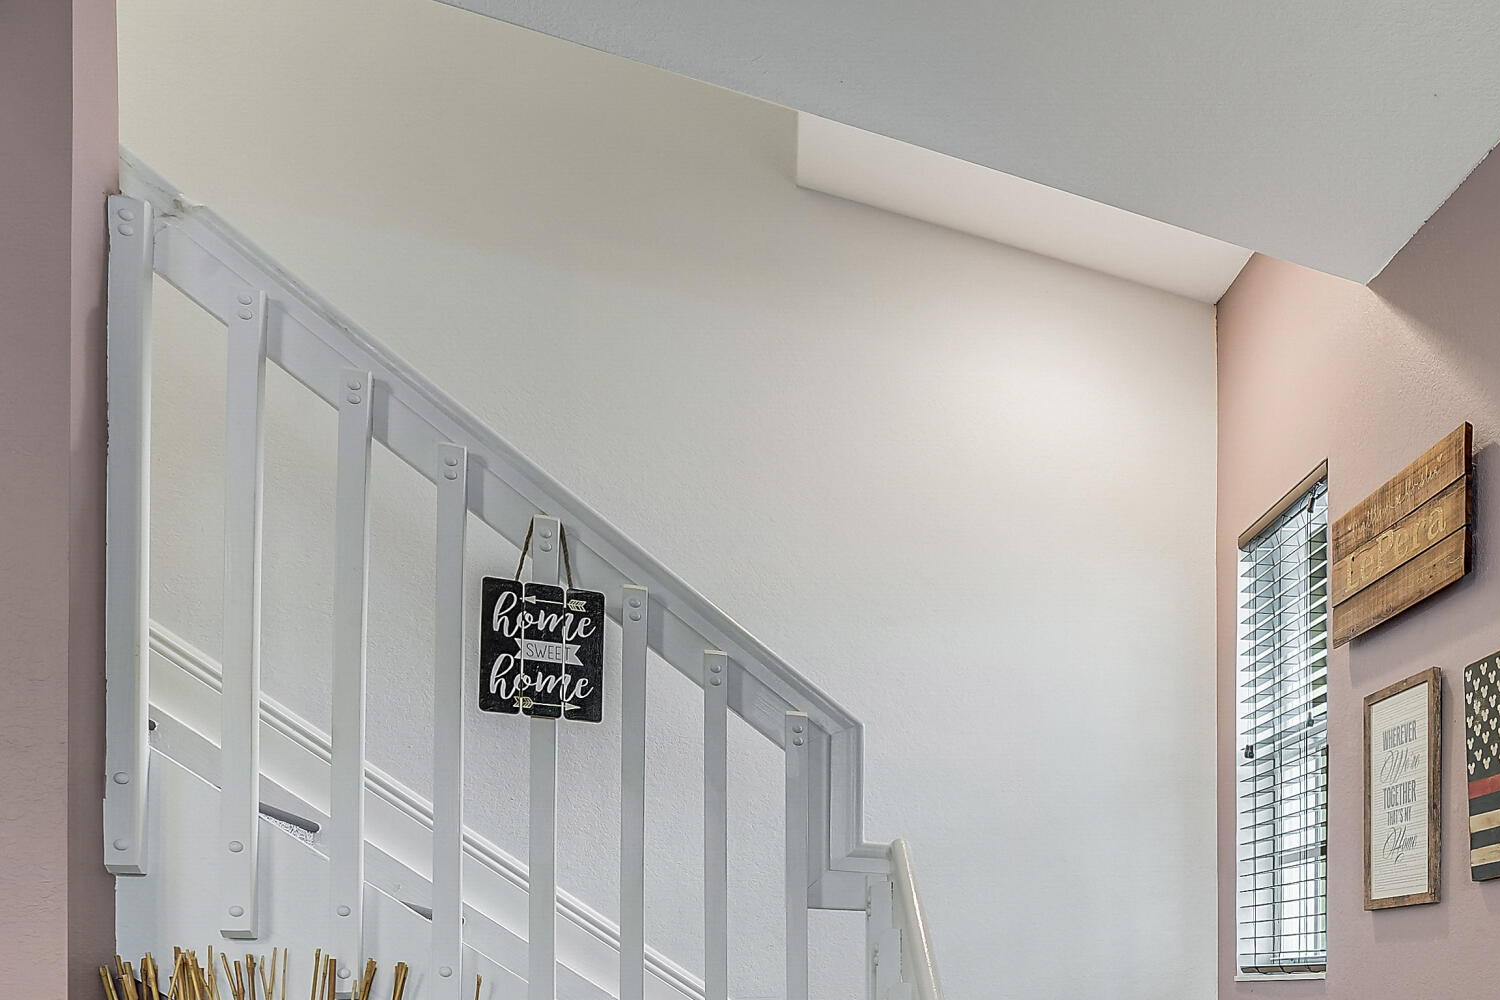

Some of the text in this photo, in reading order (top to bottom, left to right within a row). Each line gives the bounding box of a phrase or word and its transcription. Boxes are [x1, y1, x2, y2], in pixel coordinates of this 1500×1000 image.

[492, 591, 597, 642] home
[526, 642, 572, 661] SWEET
[489, 653, 594, 702] home
[1382, 719, 1417, 751] WHEREVER
[1382, 779, 1417, 811] TOGETHER
[1386, 806, 1412, 826] THAT'S MY
